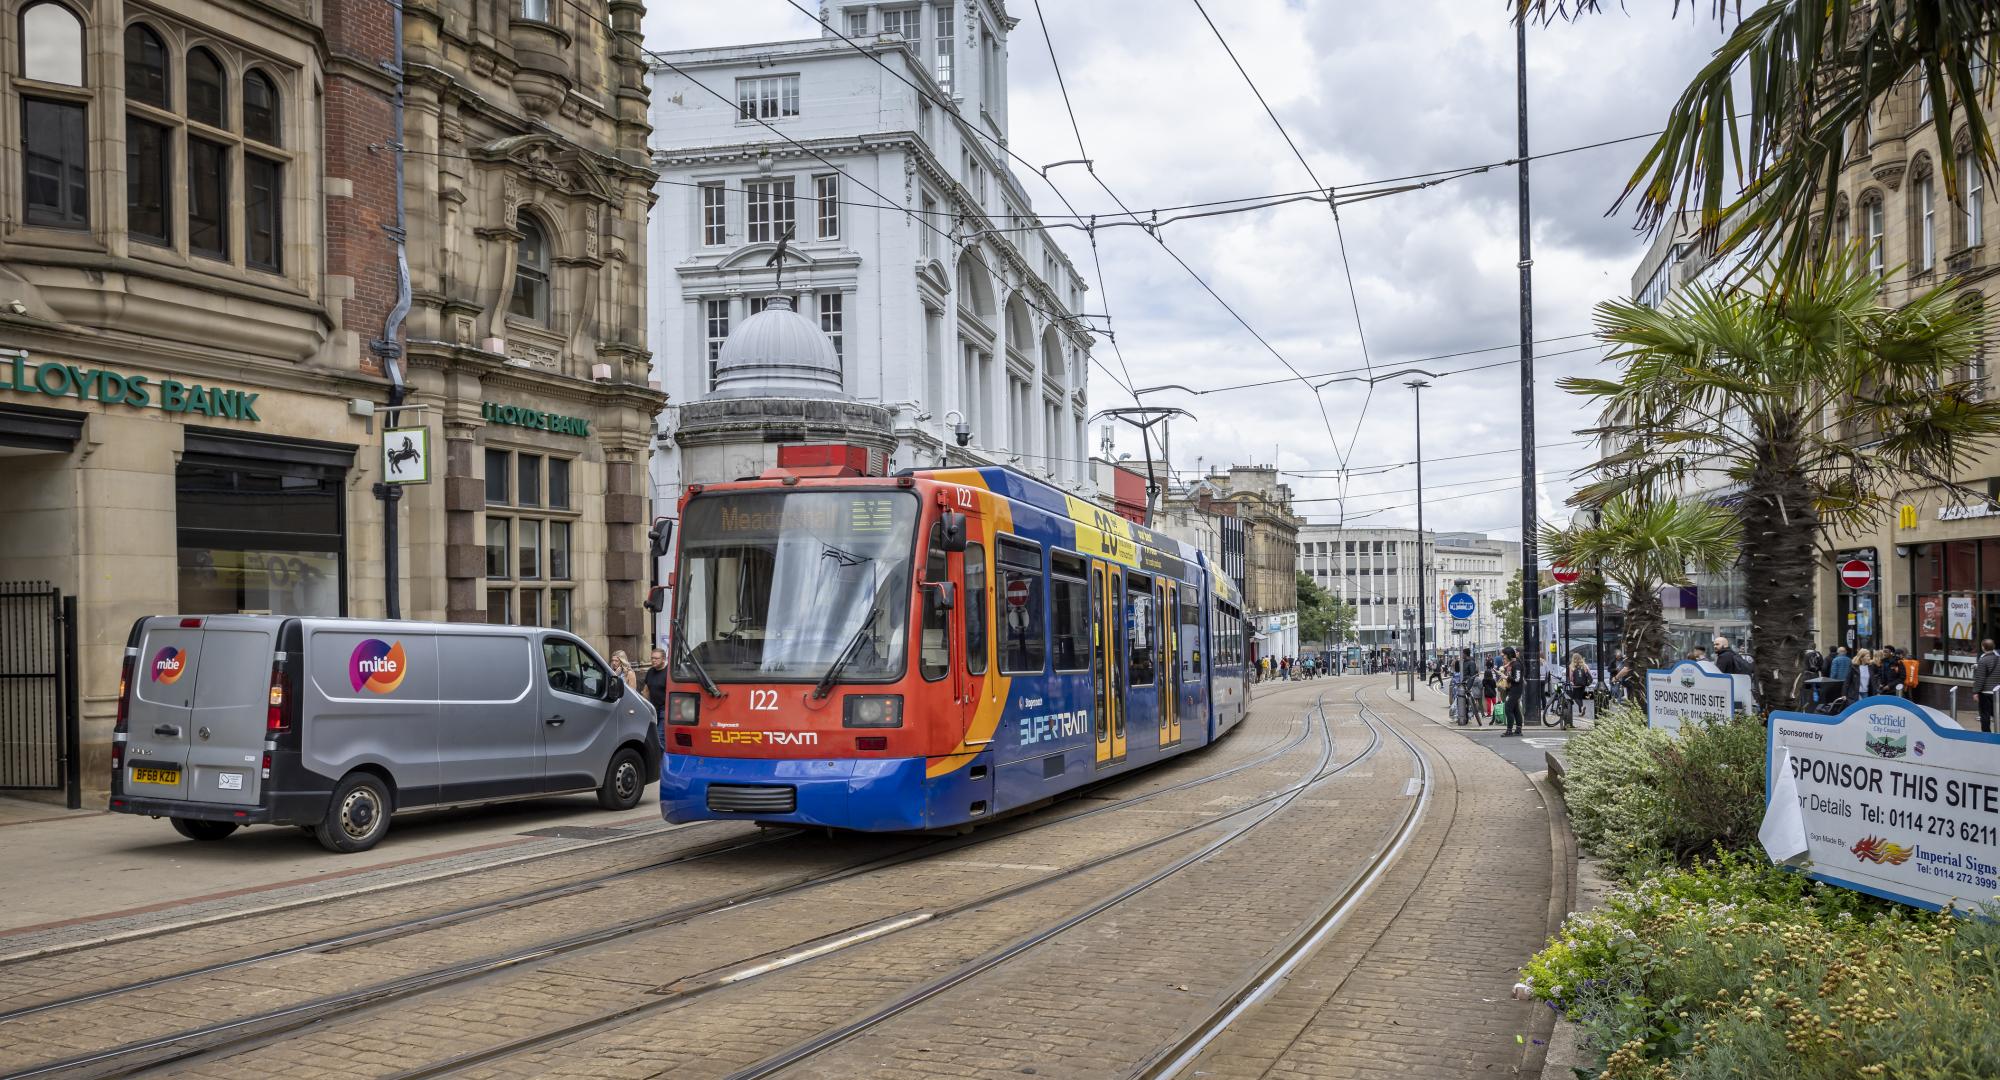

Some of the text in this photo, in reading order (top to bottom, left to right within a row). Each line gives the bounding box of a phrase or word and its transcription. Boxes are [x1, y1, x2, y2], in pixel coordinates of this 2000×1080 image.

[161, 380, 261, 422] BANK
[481, 401, 591, 437] LLOYDS BANK
[956, 487, 972, 508] 122
[156, 657, 180, 670] mitie
[359, 655, 397, 673] mitie
[749, 689, 779, 711] 122
[1654, 689, 1725, 708] SPONSOR THIS SITE
[1655, 705, 1663, 715] For
[1664, 706, 1679, 717] Details
[1869, 713, 1906, 728] Sheffield
[710, 730, 818, 745] SUPERTRAM
[1020, 710, 1088, 746] SUPERTRAM
[1778, 727, 1824, 741] Sponsored by
[1873, 725, 1882, 733] City
[159, 771, 176, 783] KZD
[1790, 755, 1999, 814] SPONSOR THIS SITE
[1810, 793, 1852, 818] Details
[1860, 802, 1884, 825] Tel:
[1889, 808, 1923, 832] 0114
[1927, 815, 1955, 838] 273
[1960, 821, 1997, 847] 6211
[1810, 832, 1847, 848] Sign Made By:
[1915, 844, 1998, 876] Imperial Signs
[1916, 862, 1997, 890] Tel: 0114 272 3999
